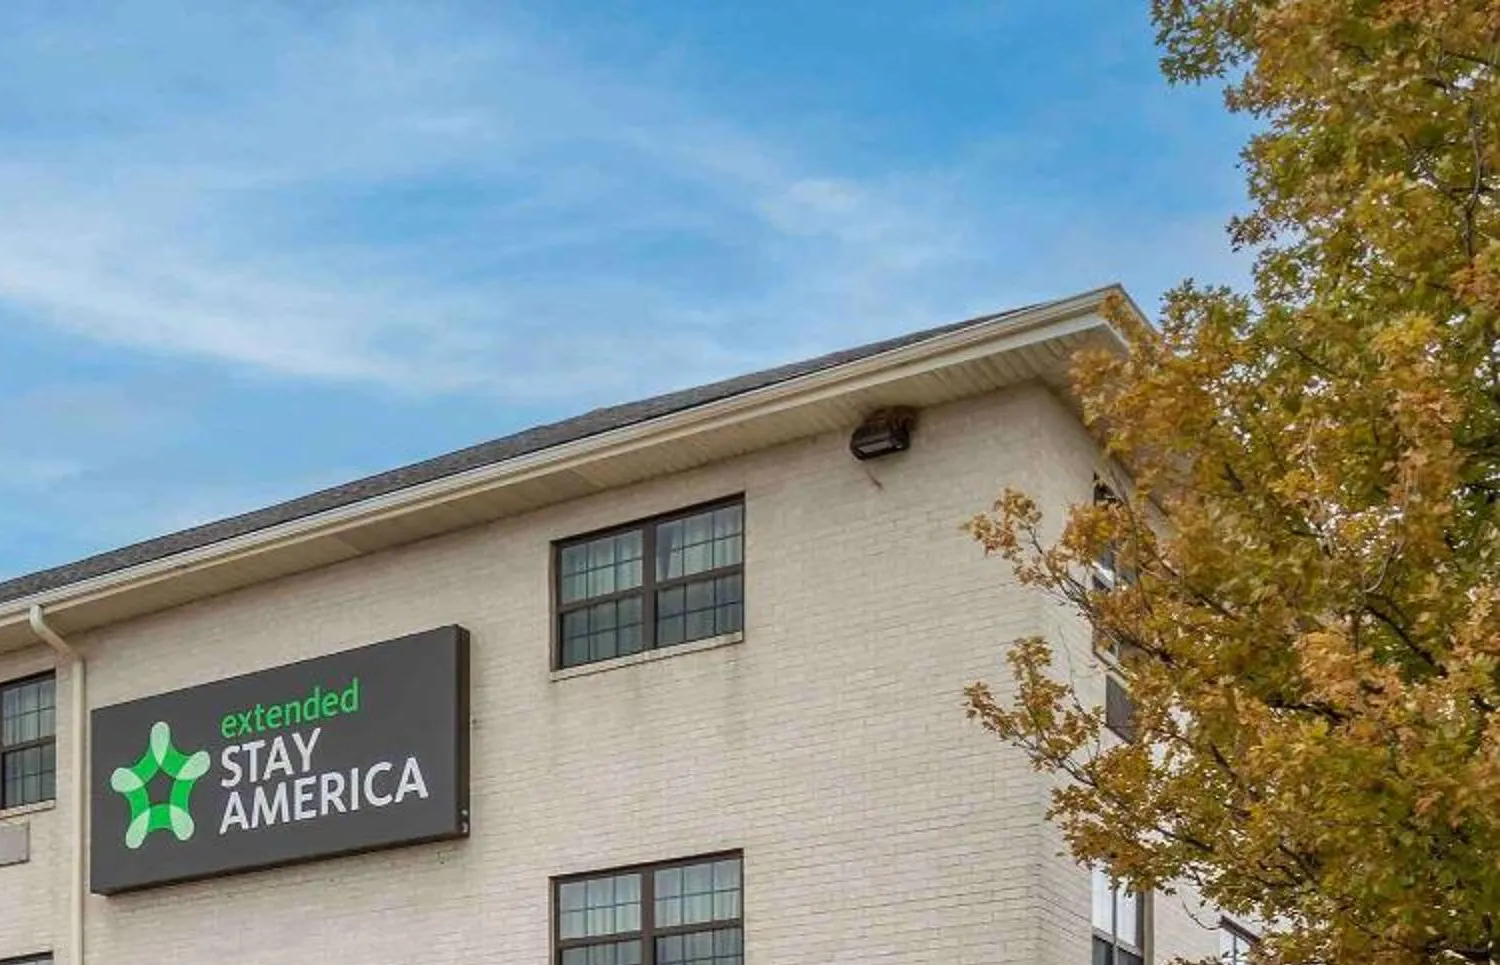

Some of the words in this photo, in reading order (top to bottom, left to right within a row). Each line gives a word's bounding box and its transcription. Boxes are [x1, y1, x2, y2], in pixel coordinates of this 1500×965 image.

[221, 677, 360, 738] extended
[221, 728, 322, 788] STAY
[219, 757, 429, 834] AMERICA
